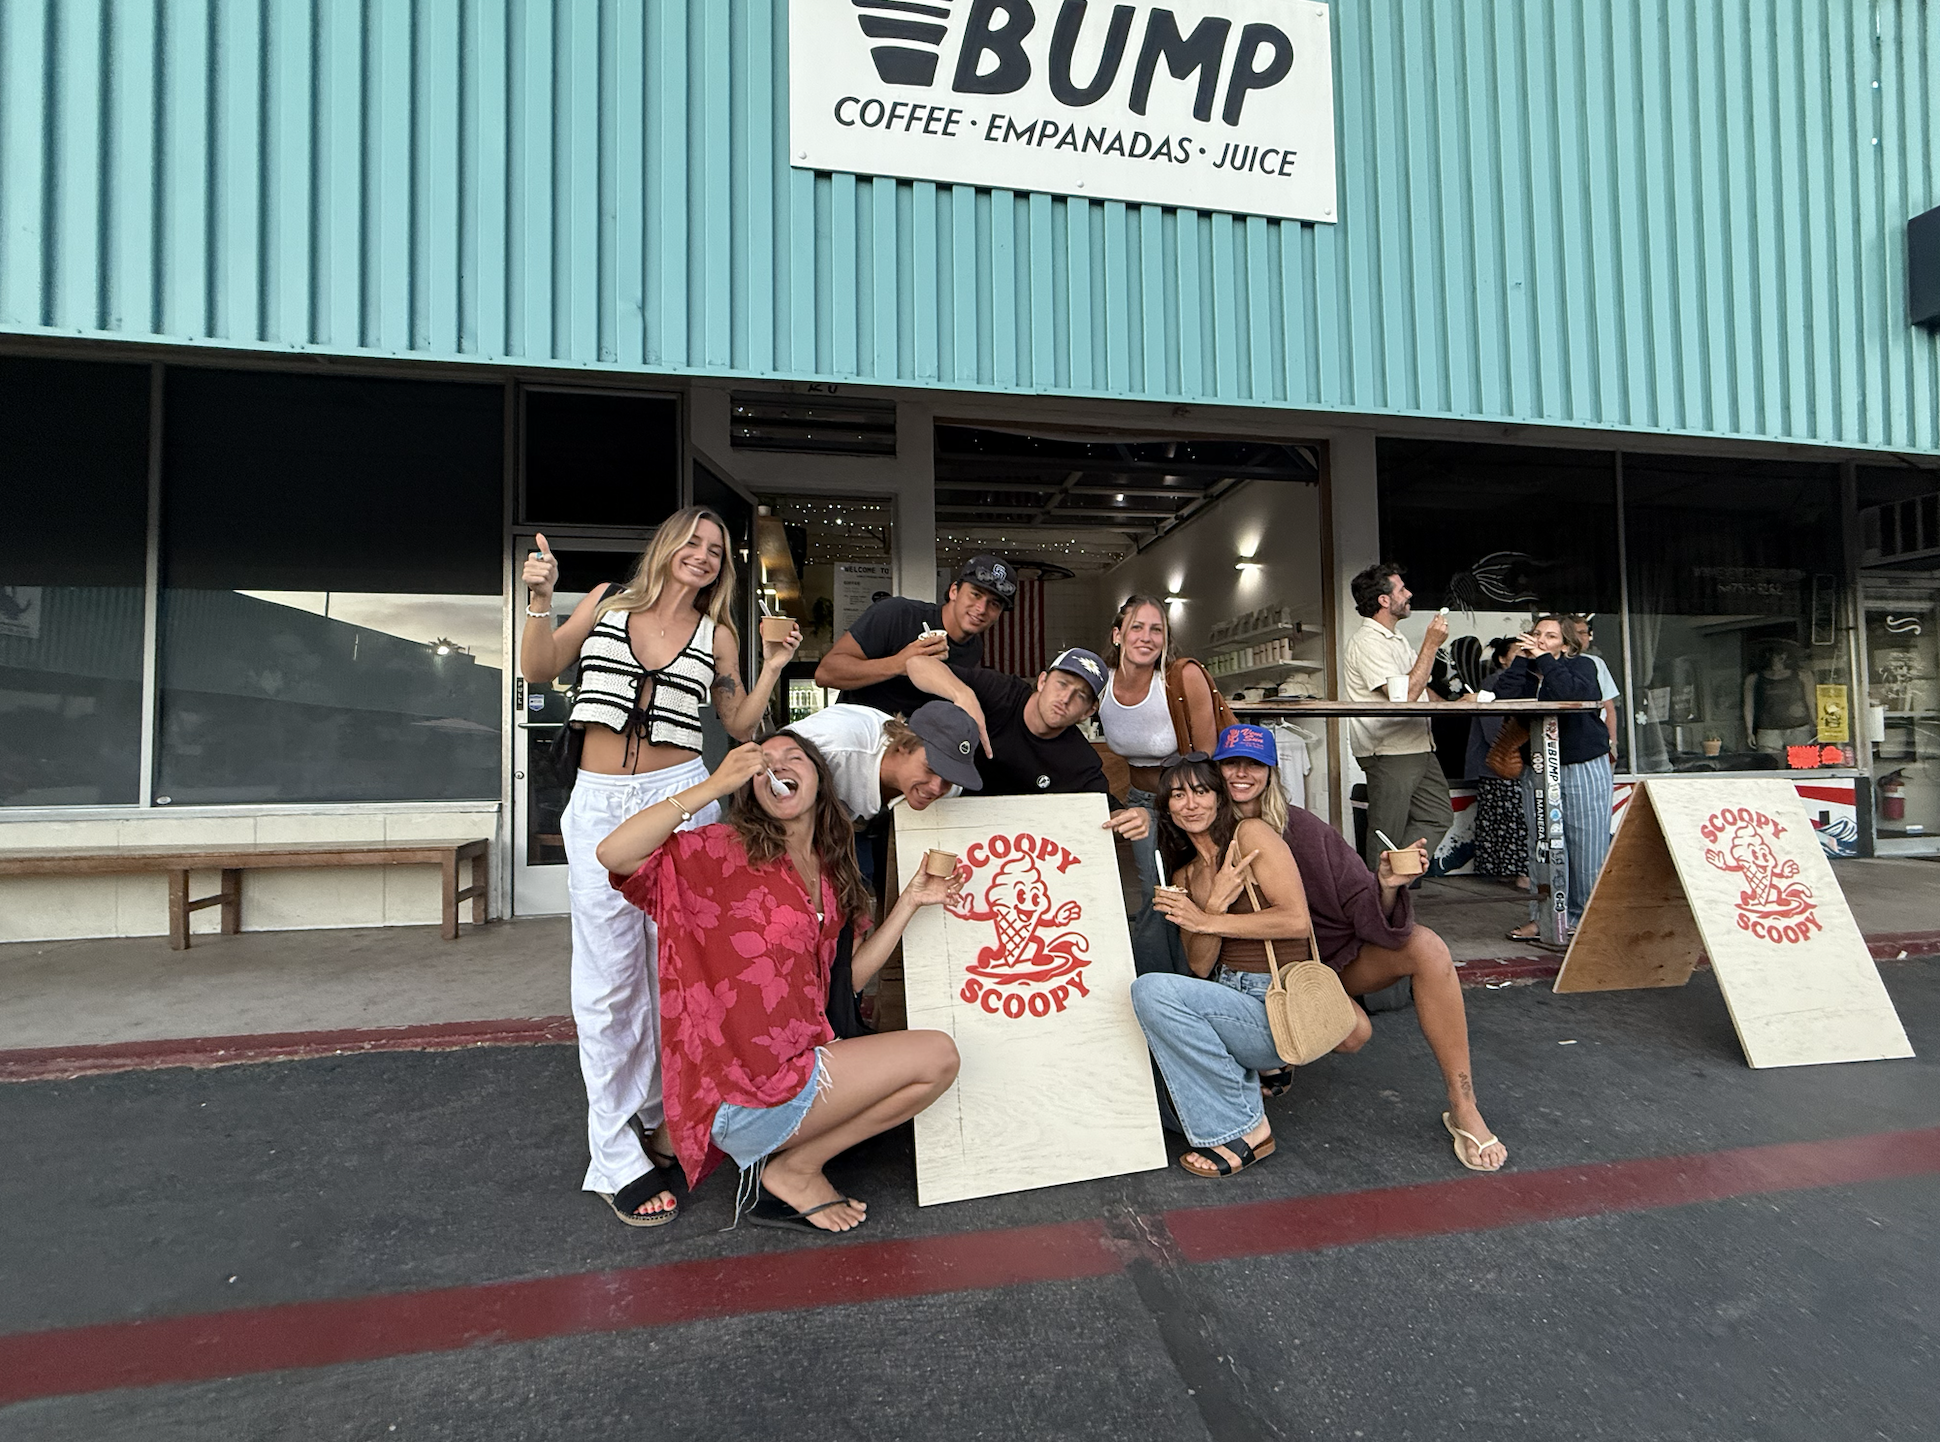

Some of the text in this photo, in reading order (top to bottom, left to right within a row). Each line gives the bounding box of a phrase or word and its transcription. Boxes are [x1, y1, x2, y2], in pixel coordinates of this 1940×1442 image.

[952, 0, 1293, 126] BUMP
[834, 96, 1297, 177] COFFEE EMPANADAS JUICE
[1547, 748, 1559, 782] BUMP
[1536, 798, 1545, 840] MANERA
[1700, 807, 1788, 844] SCOOPY
[1736, 911, 1823, 944] SCOOPY
[959, 970, 1090, 1019] SCOOPY
